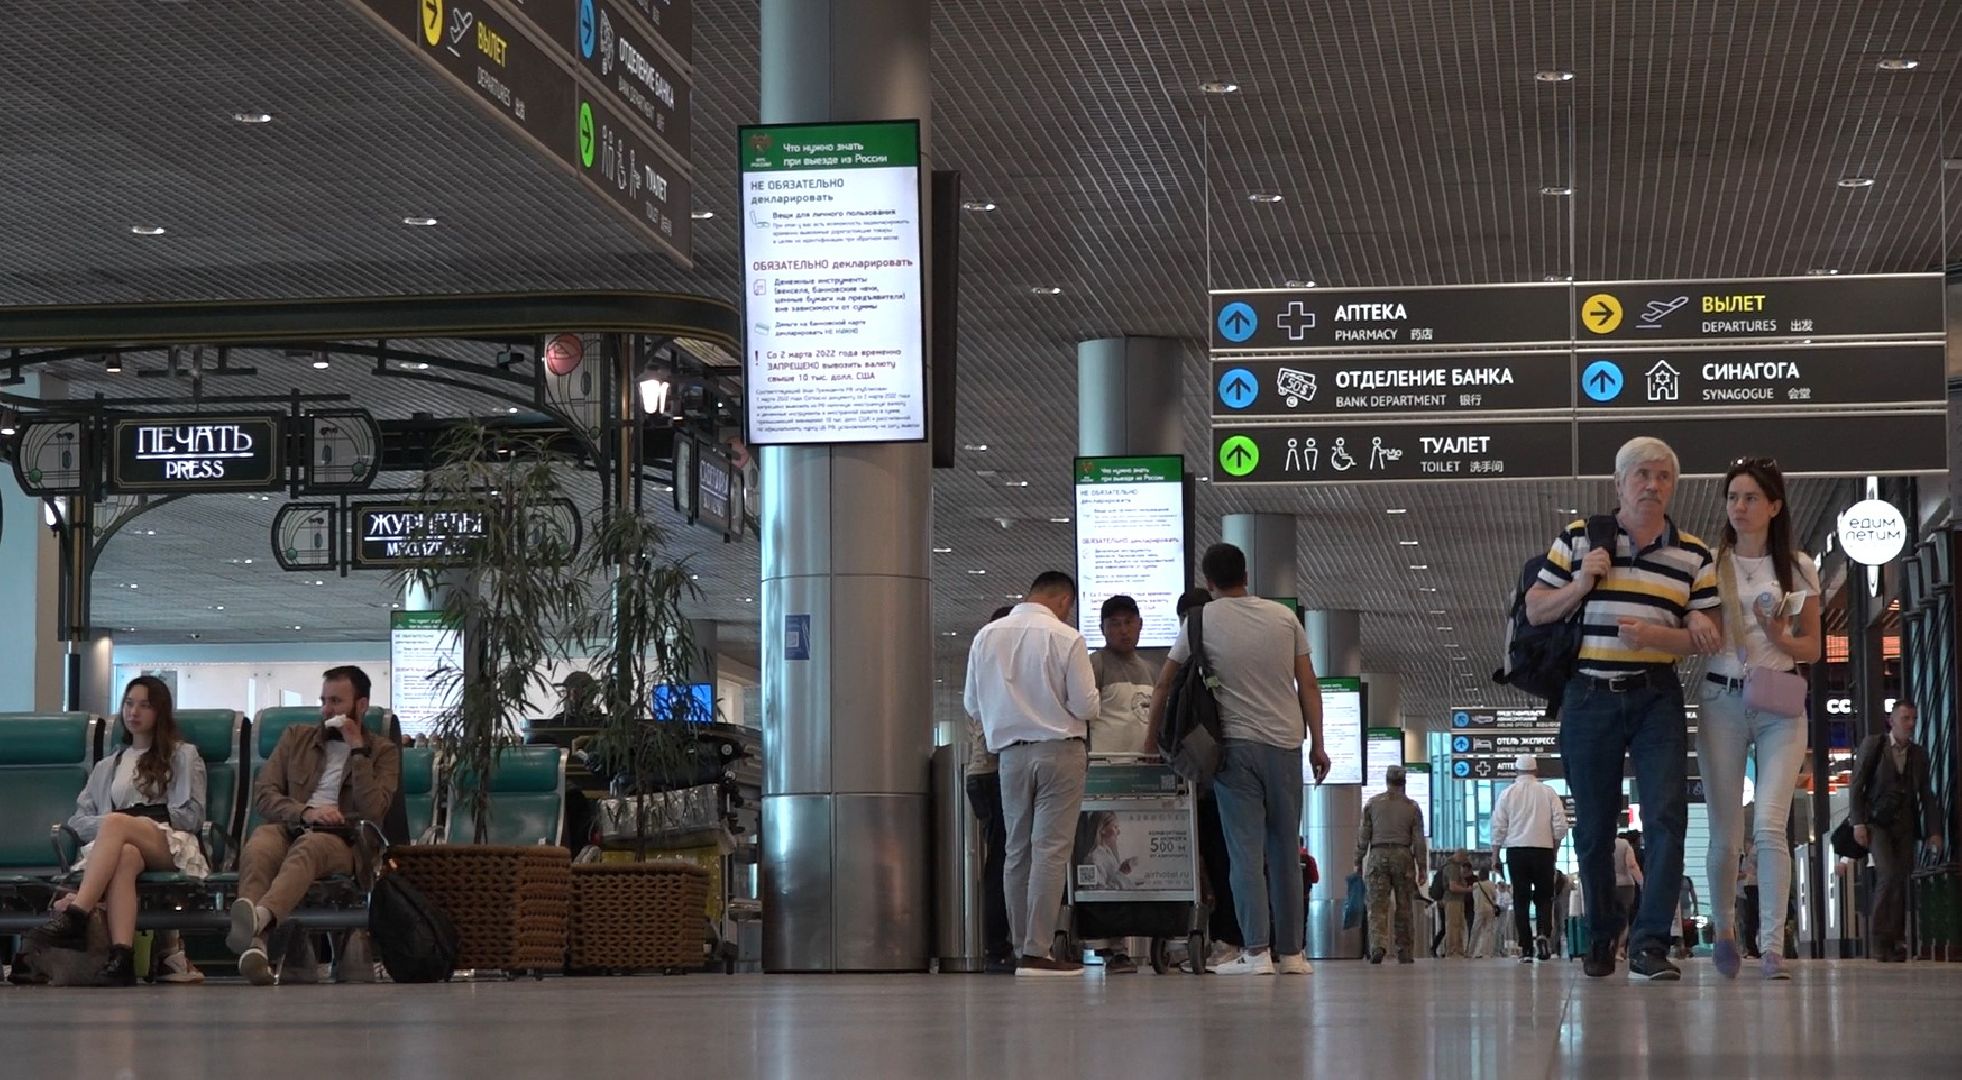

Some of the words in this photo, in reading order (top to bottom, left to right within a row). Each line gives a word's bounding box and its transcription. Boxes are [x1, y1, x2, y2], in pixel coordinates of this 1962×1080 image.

[478, 21, 507, 68] ВЫЛЕТ
[783, 143, 800, 153] Что
[803, 143, 833, 155] нужно
[837, 142, 864, 152] знать
[784, 158, 801, 169] при
[804, 156, 838, 167] выезде
[841, 156, 852, 165] из
[855, 153, 888, 164] России
[645, 164, 667, 204] ТУАЛЕТ
[751, 180, 764, 191] НЕ
[767, 178, 844, 190] ОБЯЗАТЕЛЬНО
[752, 194, 834, 206] декларировать
[753, 259, 828, 271] ОБЯЗАТЕЛЬНО
[832, 258, 913, 271] декларировать
[1702, 295, 1766, 313] ВЫЛЕТ
[1334, 303, 1407, 321] АПТЕКА
[1702, 319, 1776, 333] DEPARTURES
[1335, 328, 1398, 341] PHARMACY
[767, 351, 777, 360] Со
[789, 352, 812, 362] марта
[816, 349, 836, 359] 2022
[838, 350, 858, 359] года
[861, 348, 902, 359] временно
[768, 361, 820, 371] ЗАПРЕЩЕНО
[822, 360, 862, 369] вывозить
[865, 360, 896, 370] валюту
[1702, 361, 1800, 381] СИНАГОГА
[856, 371, 876, 381] США
[1336, 369, 1446, 389] ОТДЕЛЕНИЕ
[1452, 367, 1514, 387] БАНКА
[1336, 396, 1368, 408] BANK
[1371, 394, 1447, 408] DEPARTMENT
[1702, 387, 1774, 401] SYNAGOGUE
[138, 425, 252, 453] ПЕЧАТЬ
[1419, 435, 1490, 454] ТУАЛЕТ
[166, 460, 224, 480] PRESS
[1420, 460, 1461, 473] TOILET
[1151, 837, 1175, 852] 500
